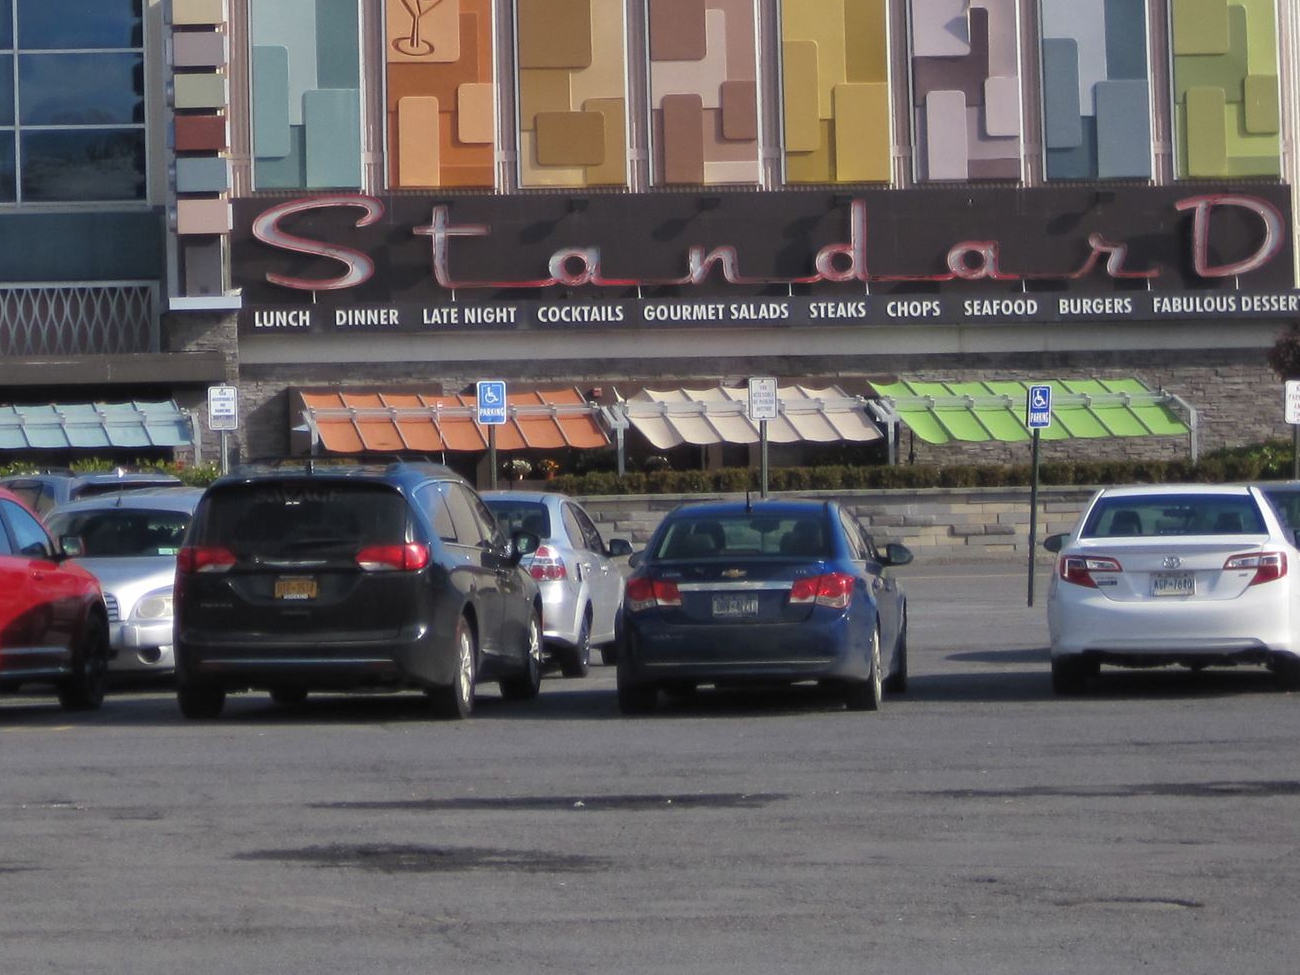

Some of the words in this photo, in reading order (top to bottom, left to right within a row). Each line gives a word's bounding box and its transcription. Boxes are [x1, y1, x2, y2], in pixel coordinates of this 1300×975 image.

[254, 310, 311, 328] LUNCH
[335, 309, 399, 326] DINNER
[422, 307, 459, 325] LATE
[464, 306, 517, 324] NIGHT
[537, 305, 624, 323] COCKTAILS
[643, 304, 725, 322] GOURMET
[729, 303, 789, 320] SALADS
[809, 301, 867, 318] STEAKS
[886, 301, 941, 317] CHOPS
[964, 299, 1038, 316] SEAFOOD
[1059, 298, 1133, 315] BURGERS
[1153, 296, 1236, 313] FABULOUS
[1241, 295, 1300, 312] DESSER
[479, 407, 505, 417] PARKING
[1030, 412, 1049, 423] PARKING
